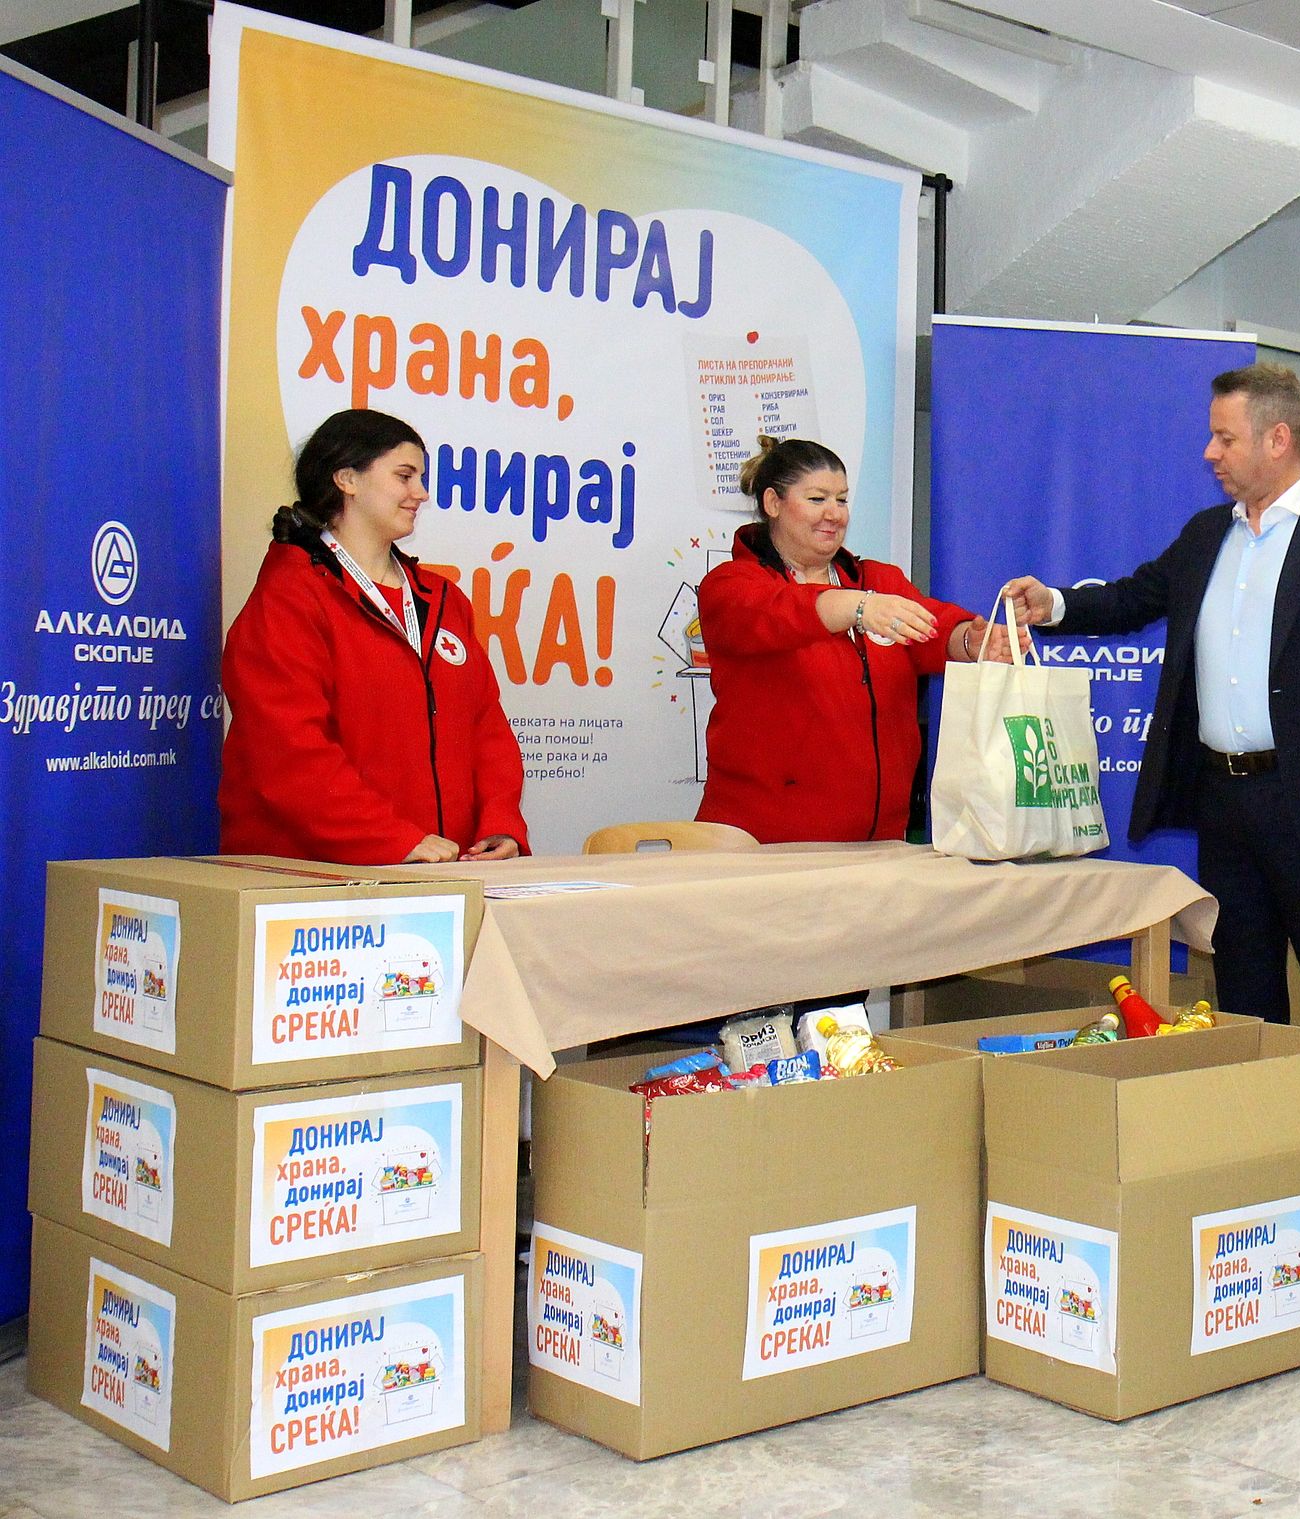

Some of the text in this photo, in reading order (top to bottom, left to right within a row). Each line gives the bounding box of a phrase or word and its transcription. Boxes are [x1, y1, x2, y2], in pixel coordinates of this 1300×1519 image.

[352, 163, 715, 319] ДОНИРАЈ
[298, 305, 575, 422] храна,
[698, 358, 794, 370] ЛИСТА НА ПРЕПОРАЧАНИ
[699, 372, 795, 386] АРТИКЛИ ЗА ДОНИРАЊЕ:
[760, 388, 809, 400] КОНЗЕРВИРАНА
[708, 394, 726, 402] ОРИЗ
[709, 405, 726, 413] ГРАВ
[762, 403, 779, 412] РИБА
[710, 417, 724, 425] СОЛ
[763, 414, 780, 423] СУПИ
[765, 423, 797, 434] БИСКВИТИ
[713, 439, 740, 448] БРАШНО
[714, 450, 751, 460] ТЕСТЕНИНИ
[715, 463, 739, 471] МАСЛО
[716, 474, 740, 483] ГОТВЕ
[421, 442, 636, 548] нирај
[34, 609, 187, 640] АЛКАЛОИД
[418, 542, 617, 687] ЌА!
[74, 644, 153, 663] СКОПЈЕ
[1024, 644, 1165, 664] КАЛОИ
[138, 686, 190, 730] пред
[545, 733, 594, 744] помош!
[560, 719, 575, 728] на
[579, 719, 623, 729] лицата
[46, 749, 177, 772] www.alkaloid.com.mk
[525, 766, 585, 780] отребно!
[546, 753, 577, 763] рака
[581, 753, 589, 761] и
[592, 753, 608, 763] да
[111, 913, 148, 944] ДОНИРАЈ
[291, 924, 385, 956] ДОНИРАЈ
[105, 943, 129, 966] храна,
[107, 968, 137, 994] донирај
[279, 959, 346, 985] храна,
[287, 978, 365, 1007] донирај
[272, 1004, 359, 1045] СРЕЌА!
[740, 1024, 775, 1043] ОРИЗ
[101, 1095, 141, 1129] ДОНИРАЈ
[96, 1124, 122, 1151] храна,
[289, 1117, 384, 1156] ДОНИРАЈ
[100, 1149, 129, 1179] донирај
[277, 1156, 346, 1186] храна,
[285, 1173, 363, 1207] донирај
[270, 1202, 357, 1246] СРЕЌА!
[1007, 1228, 1063, 1263] ДОНИРАЈ
[1216, 1223, 1276, 1258] ДОНИРАЈ
[546, 1249, 594, 1286] ДОНИРАЈ
[779, 1241, 854, 1280] ДОНИРАЈ
[1000, 1255, 1040, 1282] храна,
[1208, 1255, 1251, 1283] храна,
[540, 1277, 574, 1306] храна,
[768, 1278, 823, 1305] храна,
[1005, 1278, 1049, 1308] донирај
[1213, 1272, 1263, 1304] донирај
[101, 1288, 139, 1327] ДОНИРАЈ
[543, 1303, 583, 1337] донирај
[773, 1291, 836, 1326] донирај
[997, 1299, 1045, 1338] СРЕЌА!
[1205, 1294, 1259, 1337] СРЕЌА!
[97, 1317, 121, 1346] храна,
[288, 1316, 385, 1363] ДОНИРАЈ
[536, 1318, 580, 1366] СРЕЌА!
[761, 1318, 830, 1360] СРЕЌА!
[98, 1342, 128, 1377] донирај
[276, 1358, 346, 1390] храна,
[284, 1373, 365, 1414] донирај
[271, 1406, 360, 1454] СРЕЌА!
